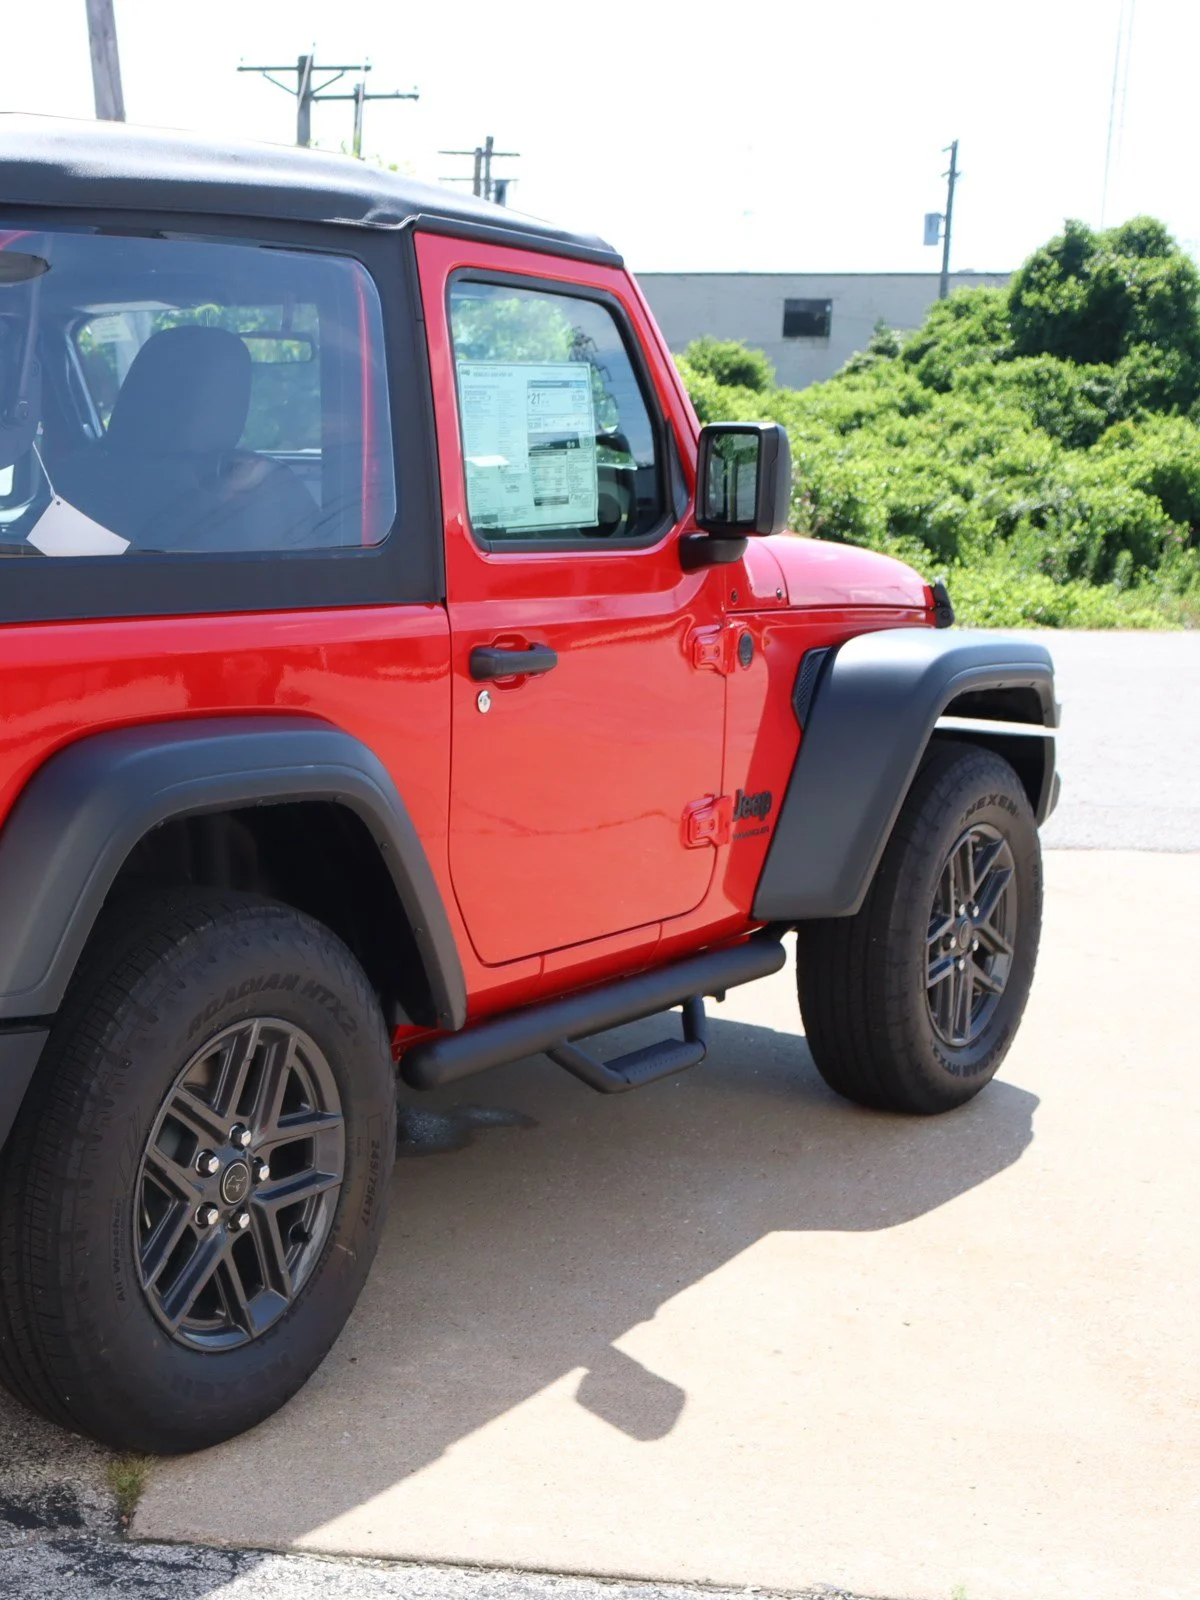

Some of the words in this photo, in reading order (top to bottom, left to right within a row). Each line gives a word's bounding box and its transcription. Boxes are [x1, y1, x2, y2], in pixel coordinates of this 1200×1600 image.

[732, 789, 772, 822] Jeep
[964, 794, 1018, 821] NEXEN
[187, 972, 301, 1041] ROADIAN
